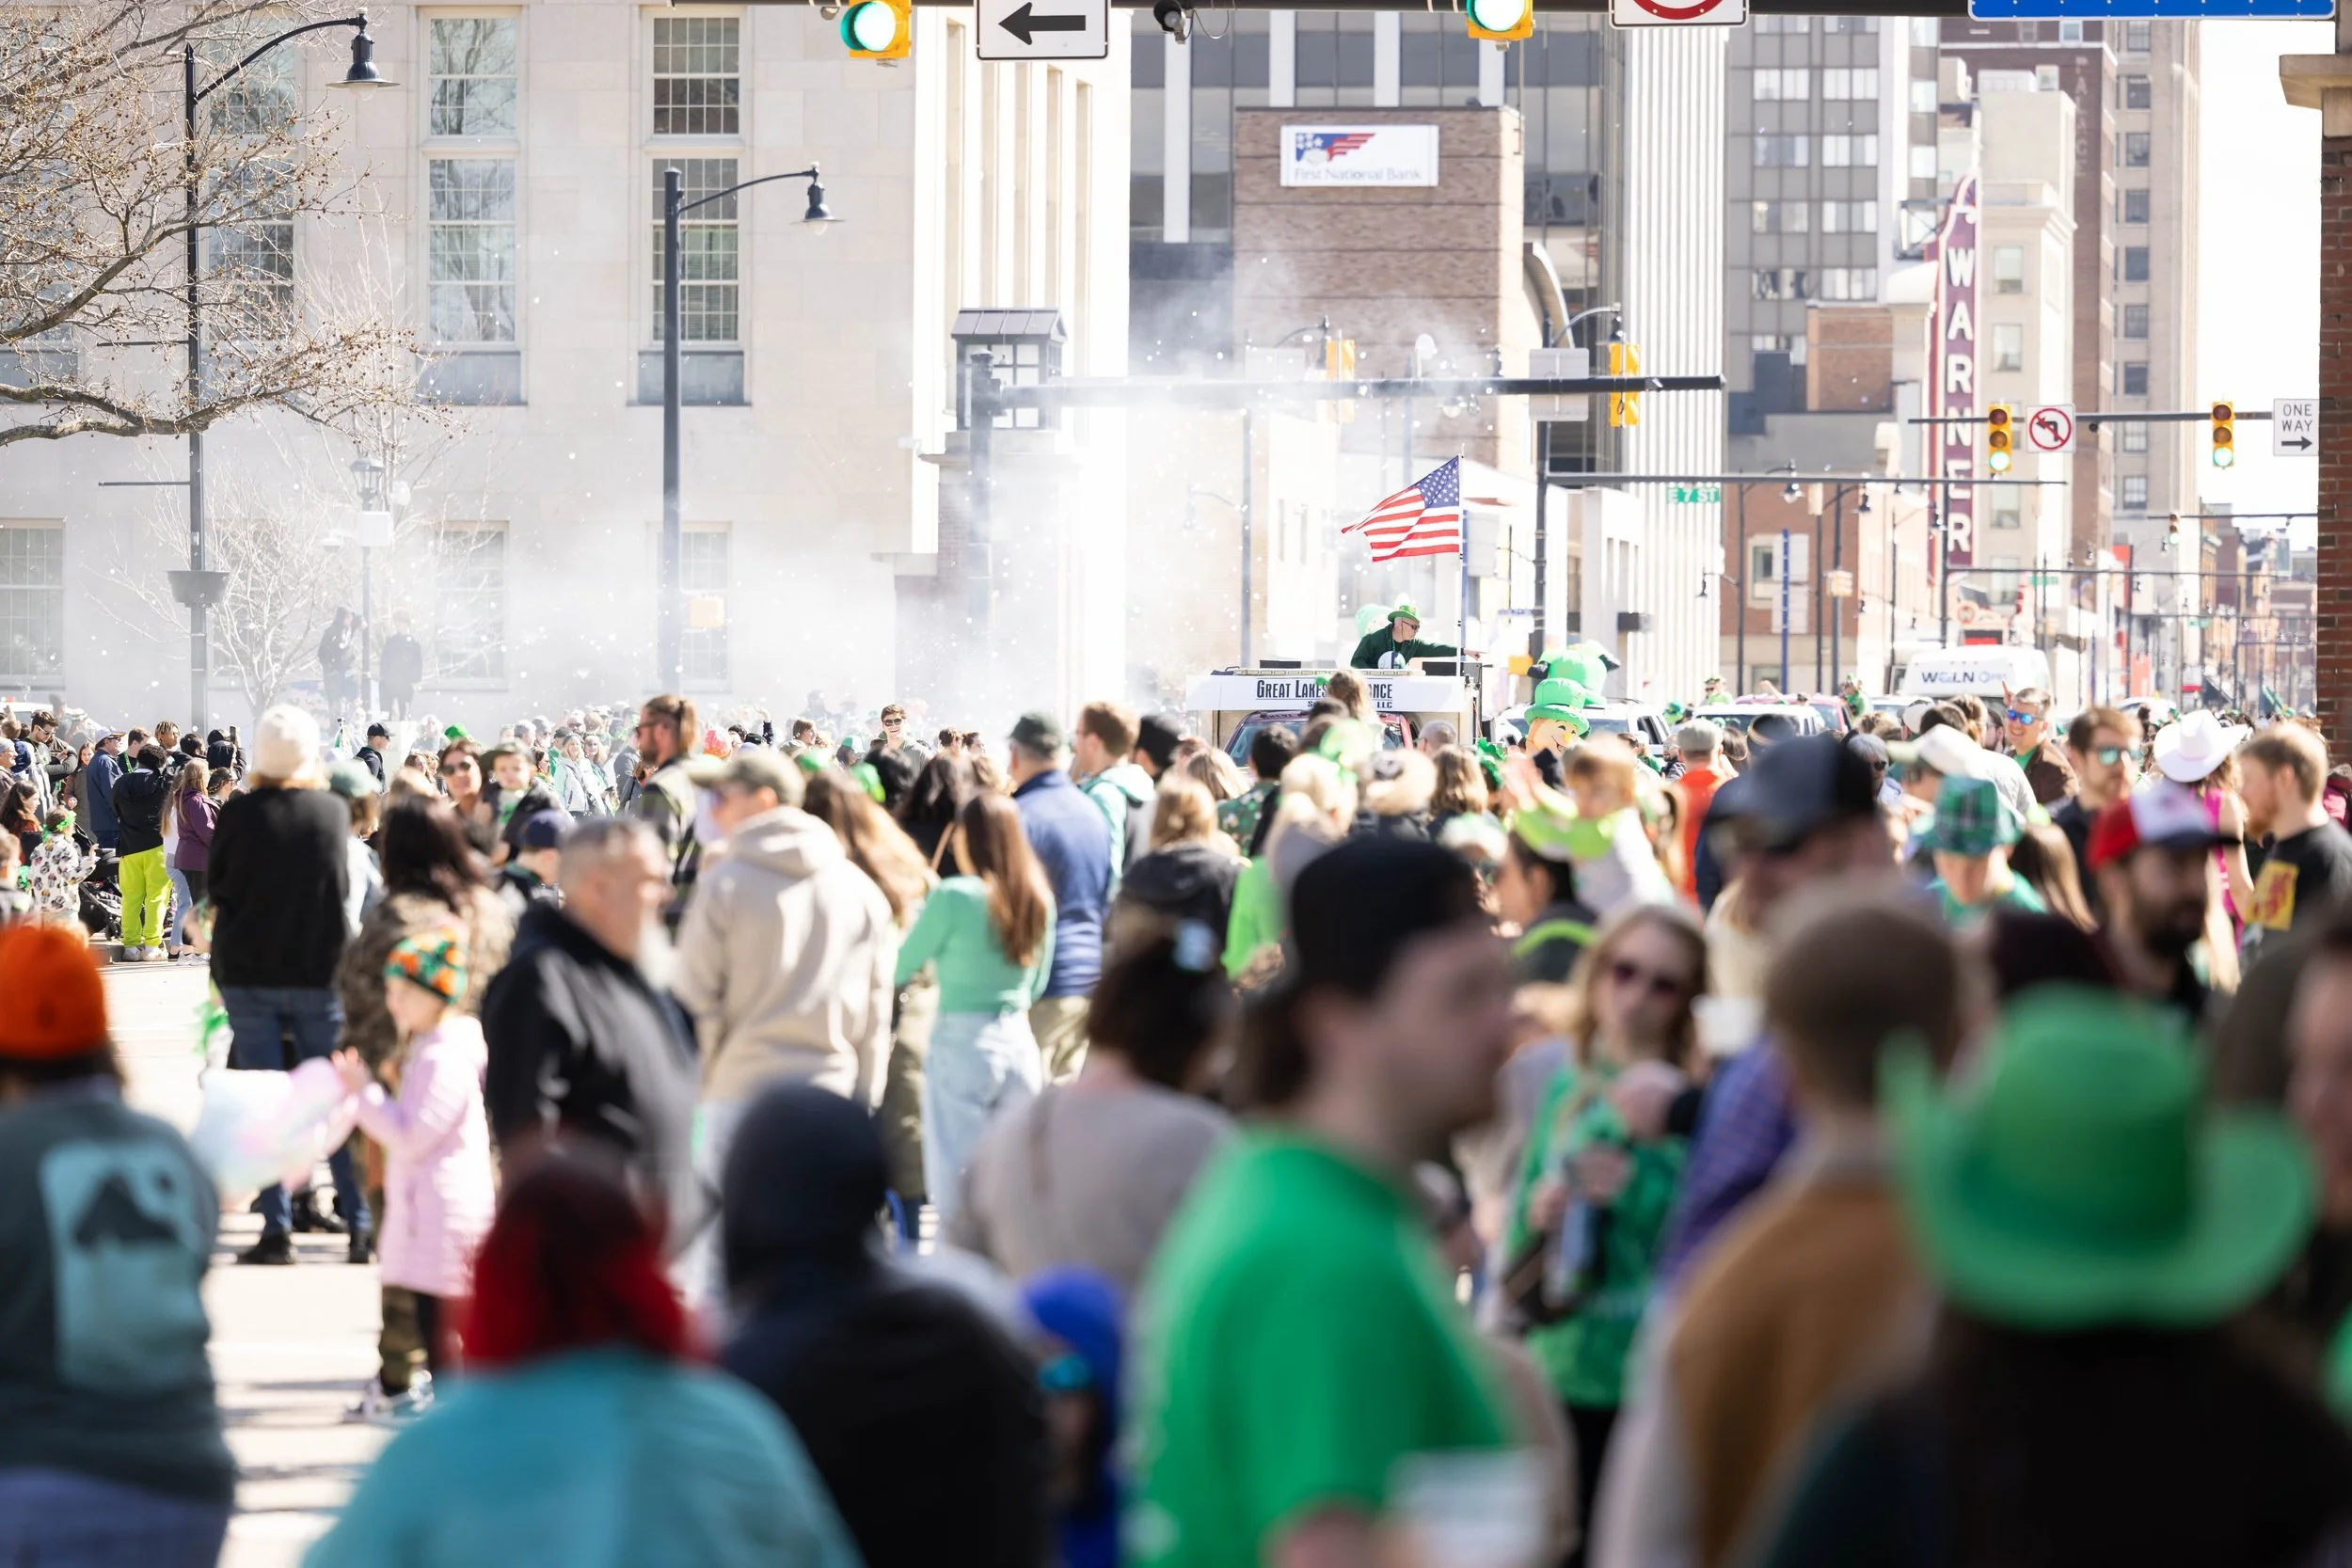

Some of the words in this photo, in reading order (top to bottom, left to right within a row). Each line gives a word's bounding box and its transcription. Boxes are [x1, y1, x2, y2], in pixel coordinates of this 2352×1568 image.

[1295, 167, 1322, 181] First
[1325, 166, 1383, 181] National
[1387, 166, 1422, 181] Bank
[1947, 247, 1975, 553] WARNER
[2283, 404, 2312, 417] ONE
[2281, 420, 2313, 432] WAY
